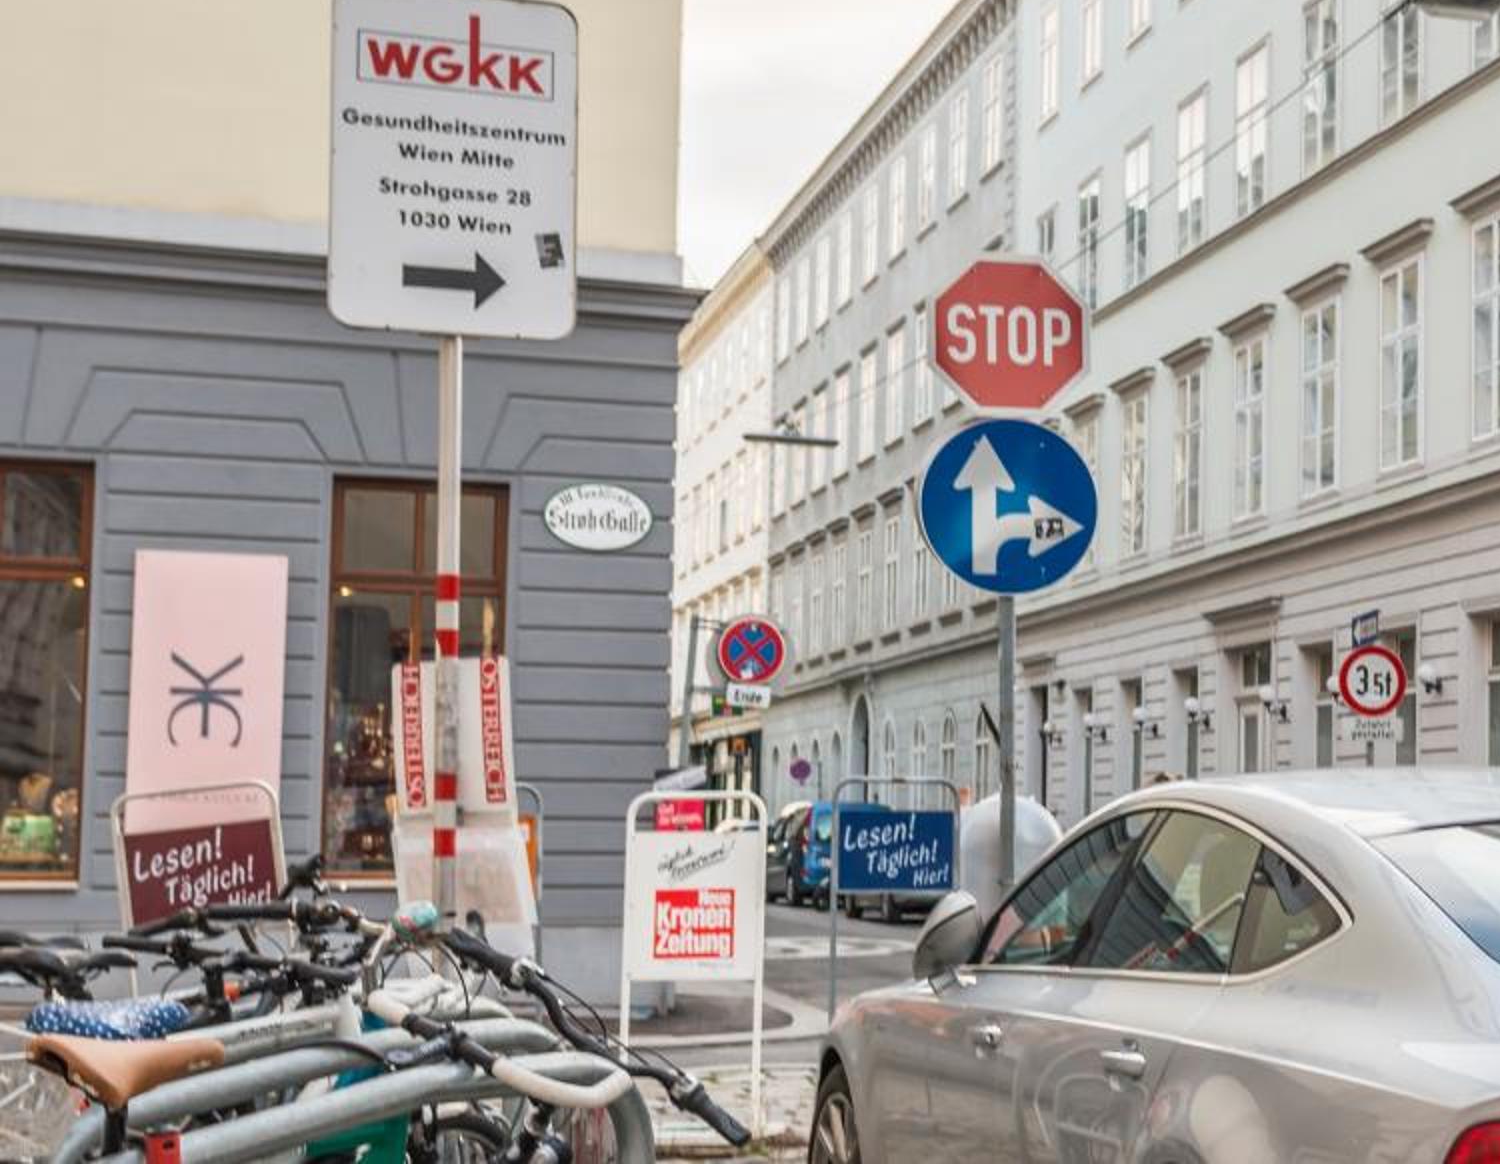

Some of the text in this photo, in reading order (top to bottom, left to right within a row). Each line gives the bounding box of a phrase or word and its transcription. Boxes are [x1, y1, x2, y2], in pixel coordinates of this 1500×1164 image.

[341, 107, 566, 146] Gesundheitszentrum
[398, 142, 515, 170] Wien Mitte
[379, 176, 532, 207] Strohgasse 28
[399, 209, 512, 235] 1030 Wien
[946, 303, 1073, 368] STOP
[844, 812, 916, 853] Lesen!
[133, 825, 223, 883] Lesen!
[866, 837, 938, 879] Täglich!
[164, 853, 254, 907] Täglich!
[912, 862, 950, 888] Hier!
[656, 901, 732, 931] Kronen
[655, 929, 732, 958] Zeitung
